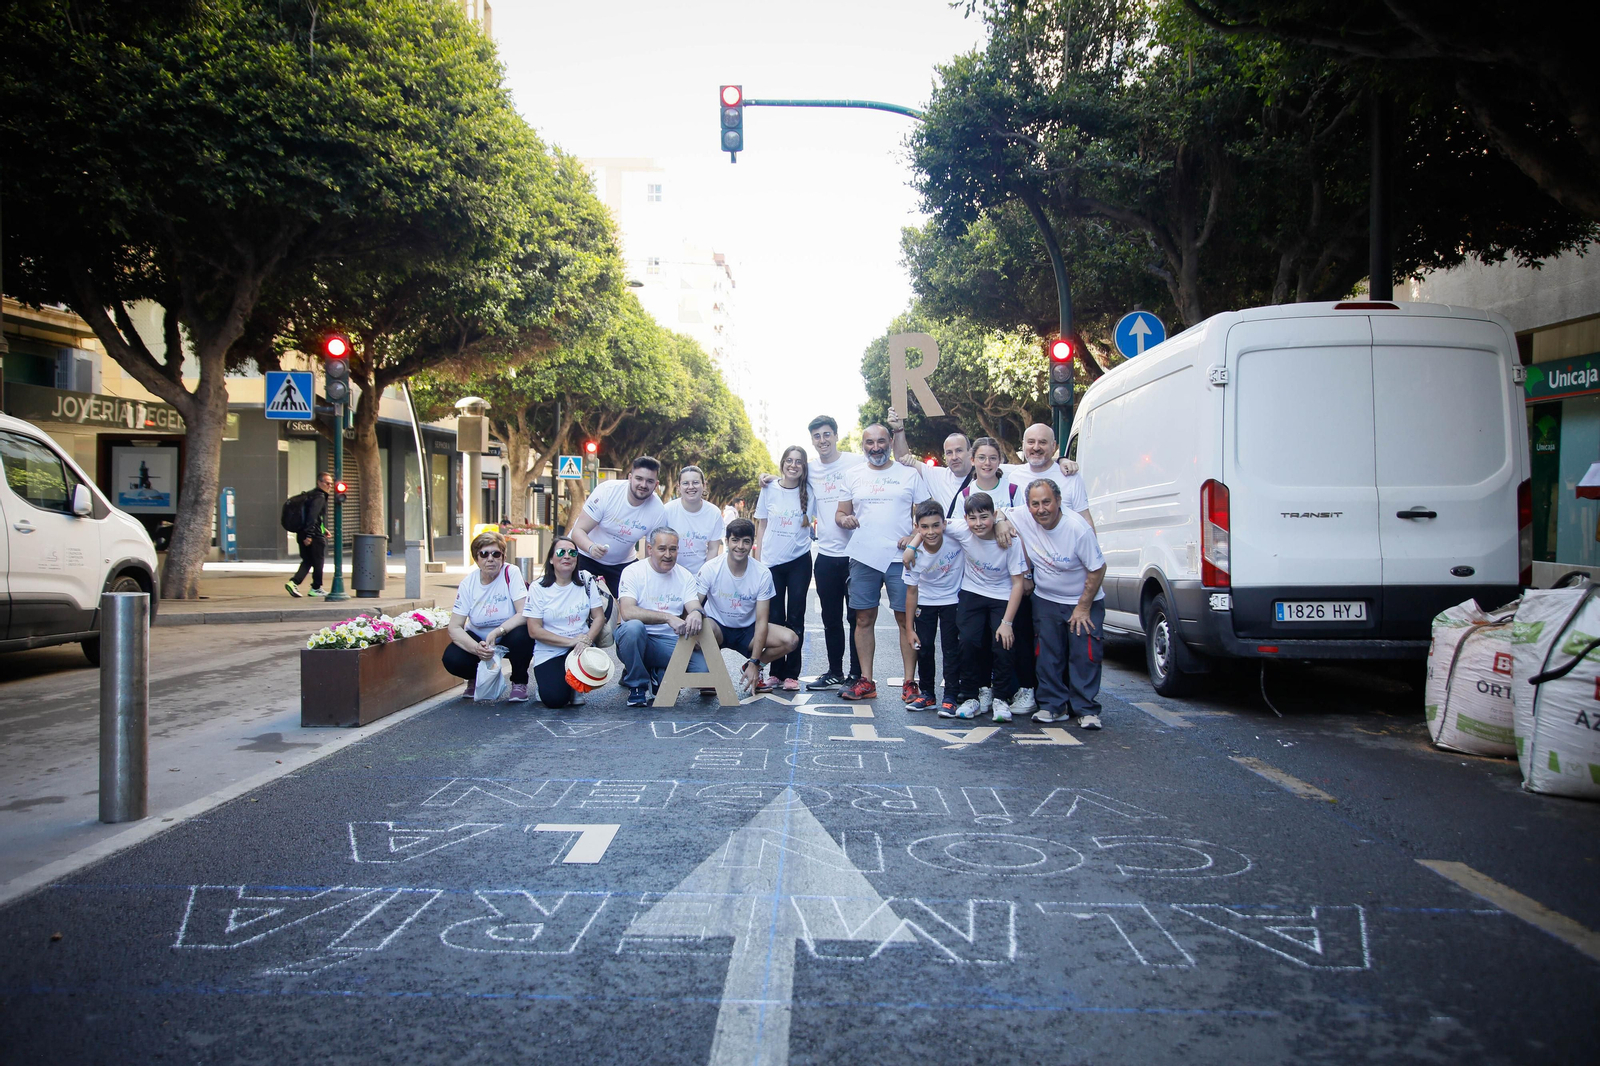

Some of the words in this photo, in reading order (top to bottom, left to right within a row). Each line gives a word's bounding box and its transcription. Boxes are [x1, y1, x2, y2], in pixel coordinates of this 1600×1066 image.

[889, 333, 946, 419] R
[1549, 361, 1599, 389] Unicaja
[292, 421, 316, 431] Sfera
[1536, 441, 1555, 452] Unicaja
[1281, 511, 1344, 519] TRANSIT
[1287, 604, 1325, 619] 1826
[1333, 604, 1363, 619] HYJ
[652, 622, 741, 708] A
[690, 747, 892, 774] DE
[347, 820, 621, 865] LA
[718, 827, 1254, 880] CON
[172, 884, 1371, 977] ALMERÍA
